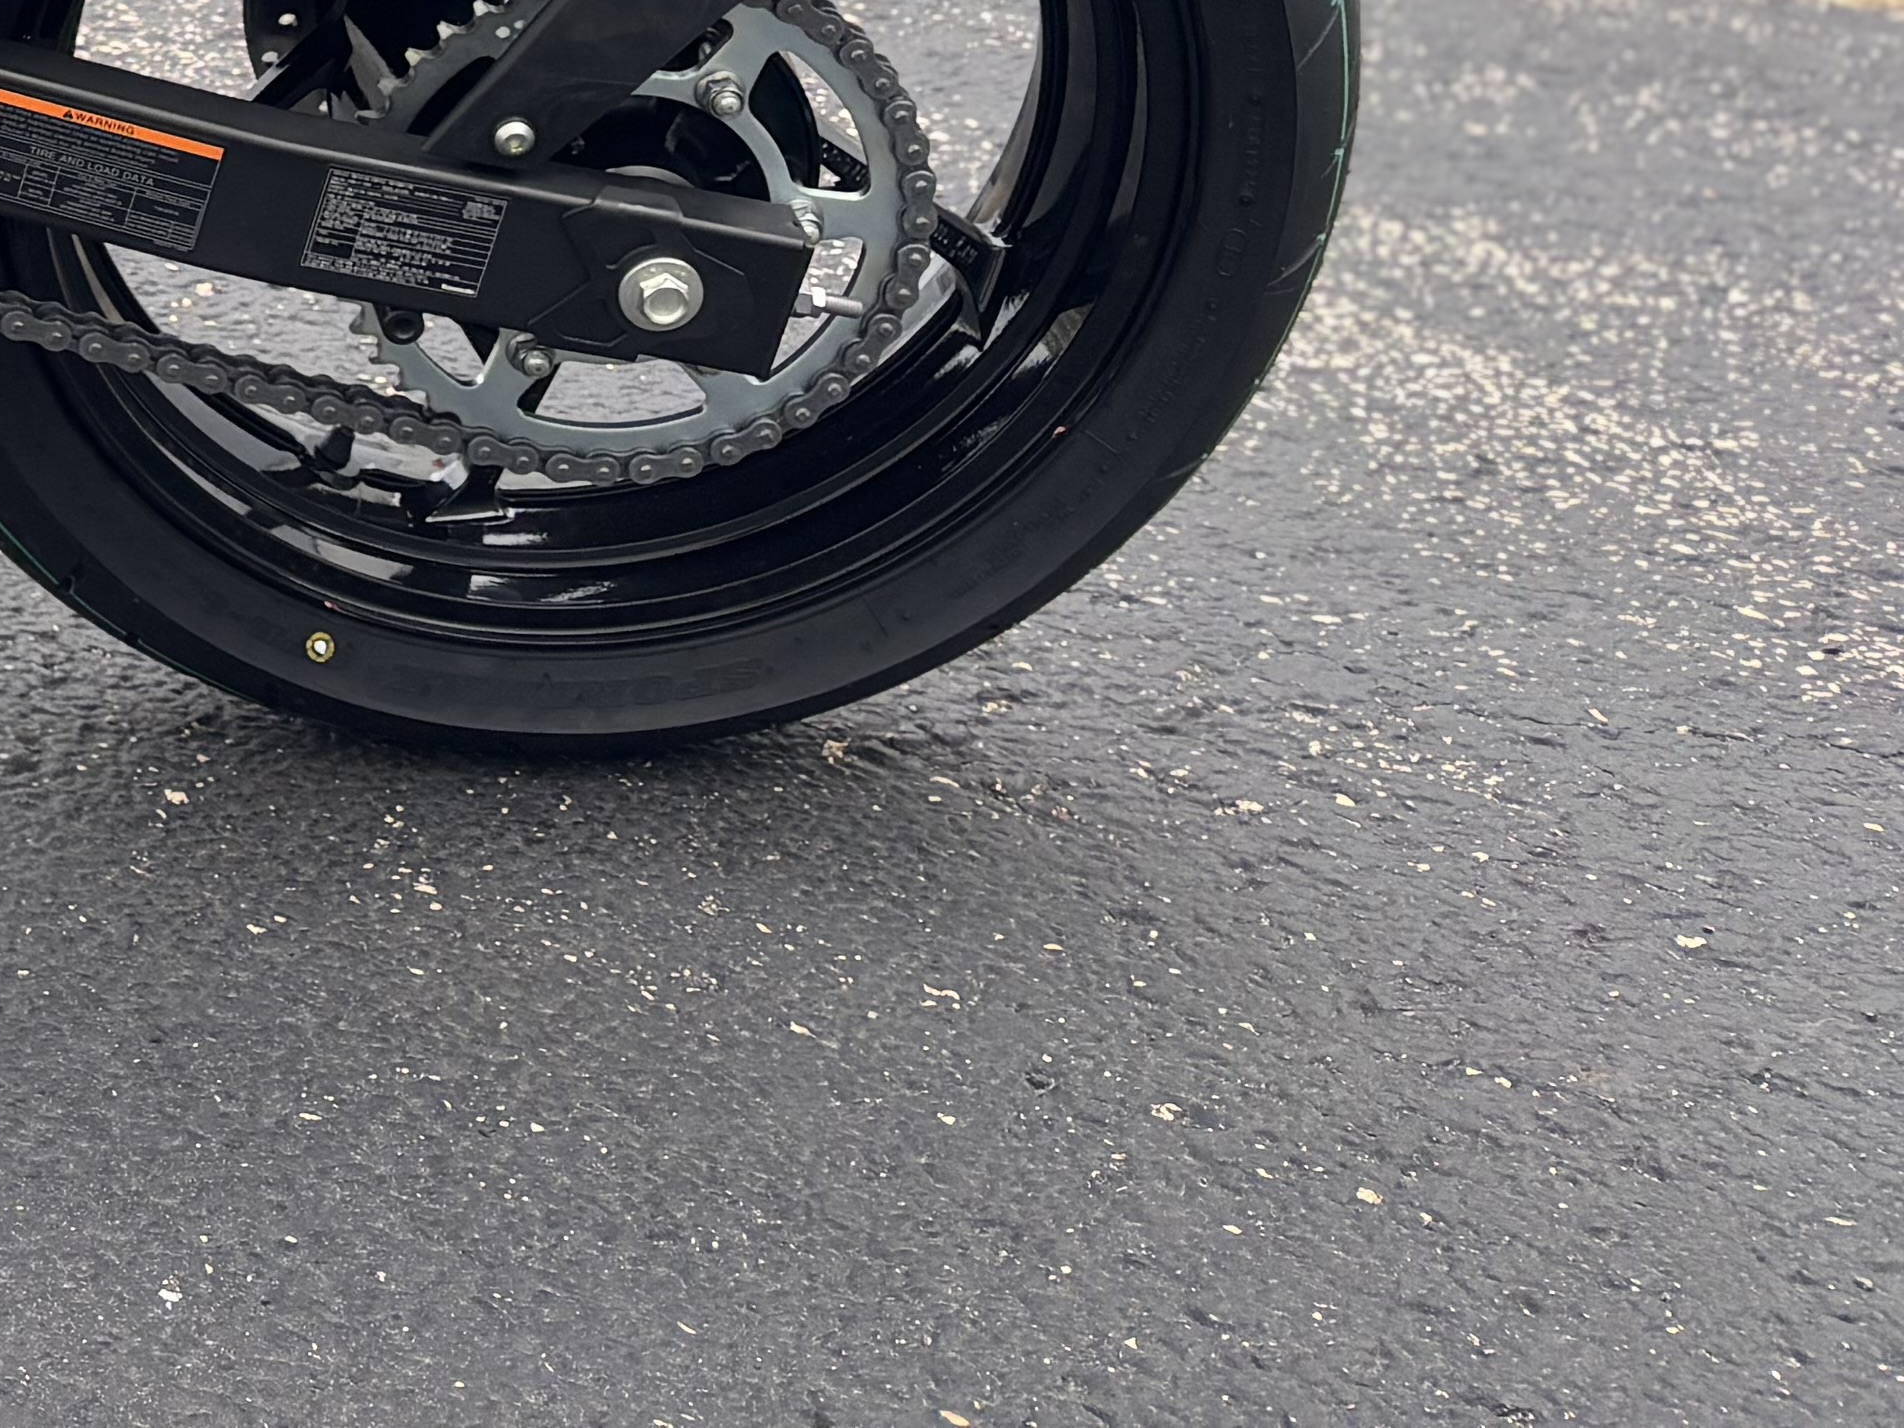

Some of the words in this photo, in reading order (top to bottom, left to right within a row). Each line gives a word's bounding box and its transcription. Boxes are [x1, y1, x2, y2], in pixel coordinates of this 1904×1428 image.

[74, 110, 136, 137] WARNING
[29, 146, 59, 161] TIRE
[59, 153, 86, 170] AND
[87, 161, 121, 178] LOAD
[122, 170, 155, 187] DATA
